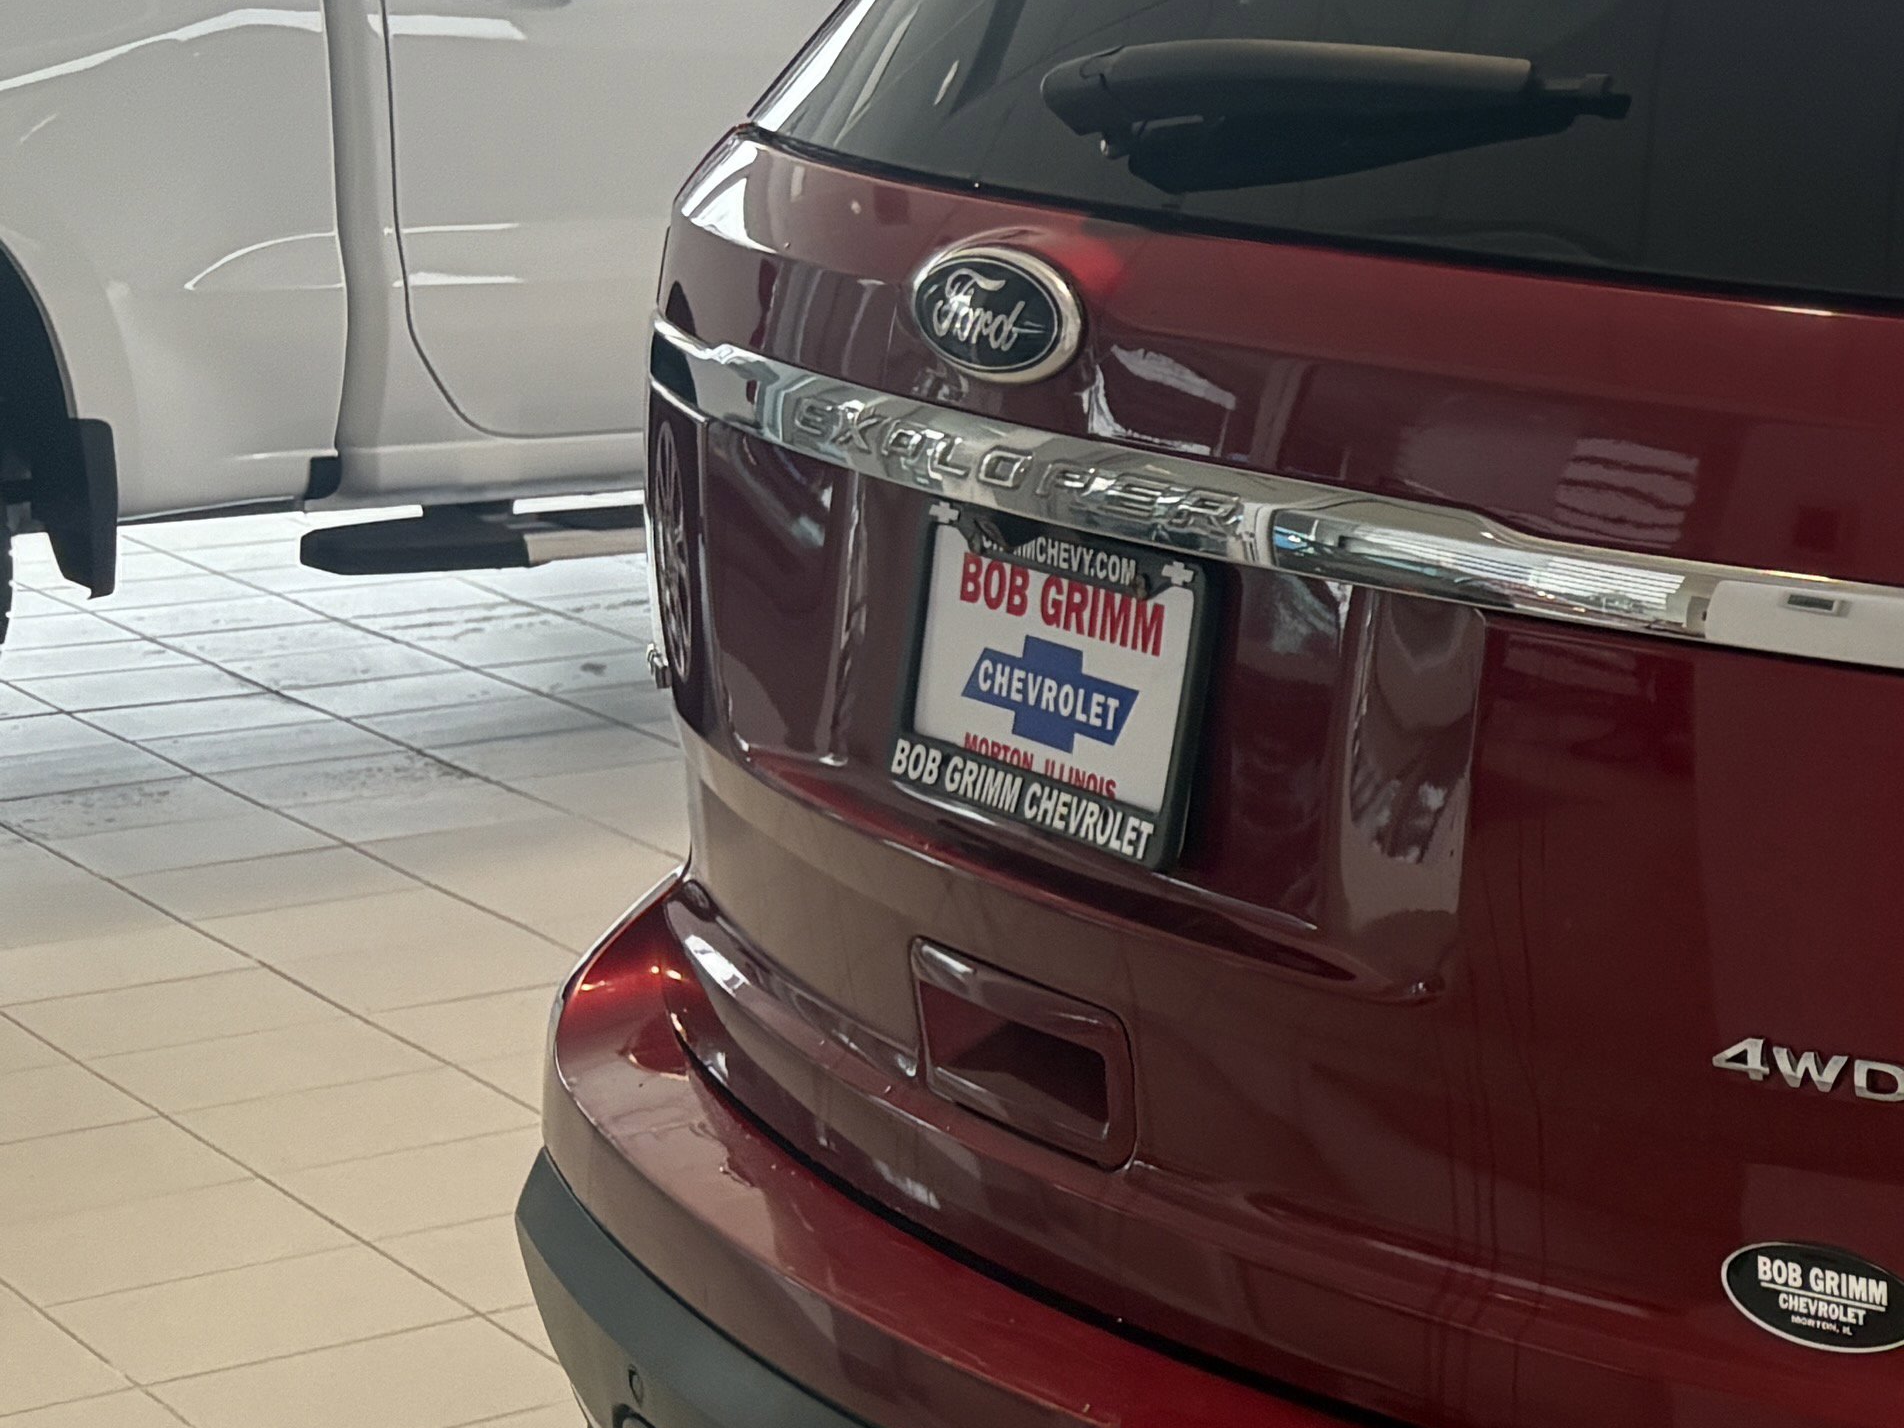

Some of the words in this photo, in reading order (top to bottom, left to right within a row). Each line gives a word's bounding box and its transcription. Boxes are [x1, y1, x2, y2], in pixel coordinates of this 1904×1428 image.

[932, 268, 1045, 352] Ford
[795, 398, 1243, 531] EXPLORER
[960, 552, 1031, 617] BOB
[1040, 575, 1165, 657] GRIMM
[978, 658, 1120, 731] CHEVROLET
[890, 738, 942, 785] BOB
[944, 755, 1024, 814] GRIMM
[1023, 782, 1155, 860] CHEVROLET
[1757, 1254, 1803, 1288] BOB
[1808, 1267, 1889, 1307] GRIMM
[1778, 1292, 1867, 1326] CHEVROLET
